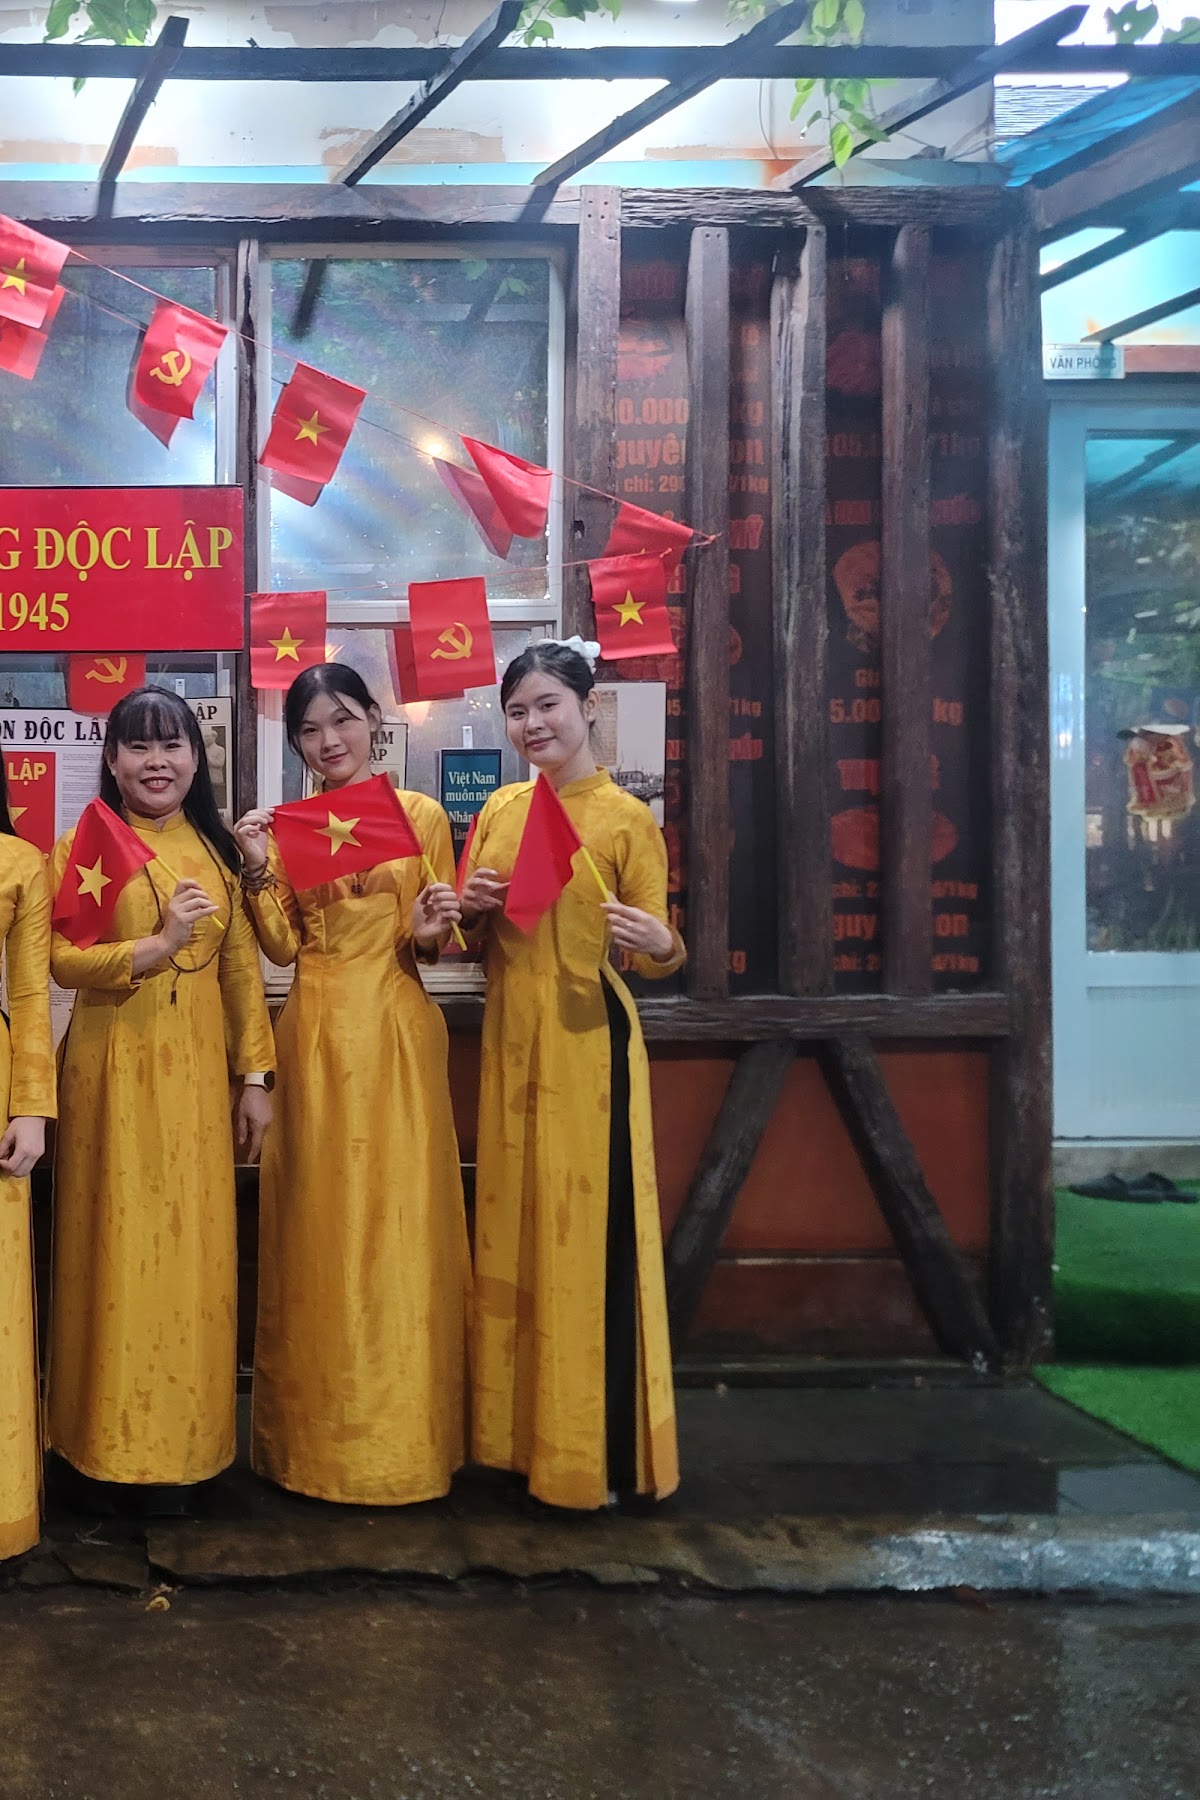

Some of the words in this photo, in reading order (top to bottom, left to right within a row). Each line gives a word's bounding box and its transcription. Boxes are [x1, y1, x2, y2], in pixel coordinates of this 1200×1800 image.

[33, 520, 132, 581] ĐỘC
[144, 519, 234, 581] LẬP
[196, 702, 218, 723] ẬP
[24, 716, 66, 744] ĐỘC
[74, 716, 109, 744] LẬ
[8, 758, 47, 785] LẬP
[448, 771, 470, 787] Việt
[472, 771, 496, 784] Nam
[445, 788, 475, 802] muôn
